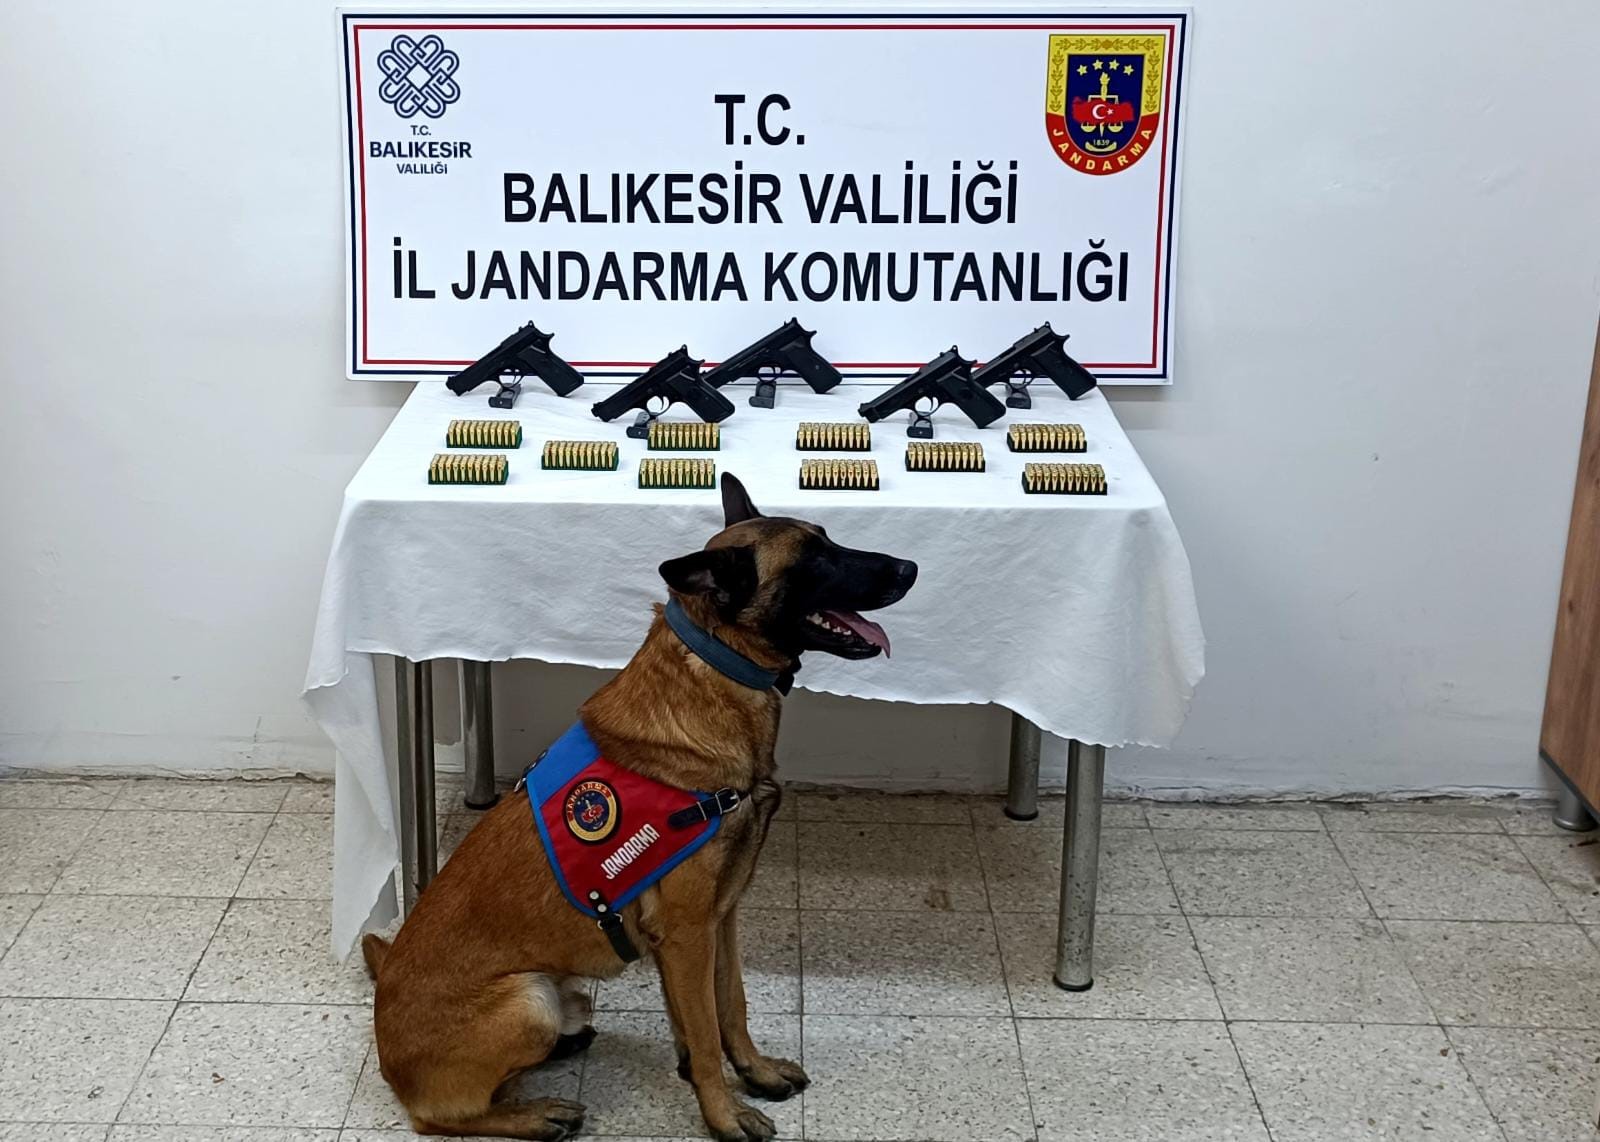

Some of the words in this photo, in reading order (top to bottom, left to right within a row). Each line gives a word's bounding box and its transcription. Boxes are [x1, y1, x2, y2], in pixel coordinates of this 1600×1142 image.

[410, 125, 432, 136] T.C.
[714, 93, 806, 146] T.C.
[1052, 128, 1152, 171] JANDARMA
[503, 160, 783, 225] BALIKESİR
[799, 160, 1018, 225] VALİLİĞİ
[393, 236, 436, 299] İL
[452, 250, 748, 302] JANDARMA
[764, 238, 1129, 303] KOMUTANLIĞI
[600, 823, 661, 880] JANDARMA
